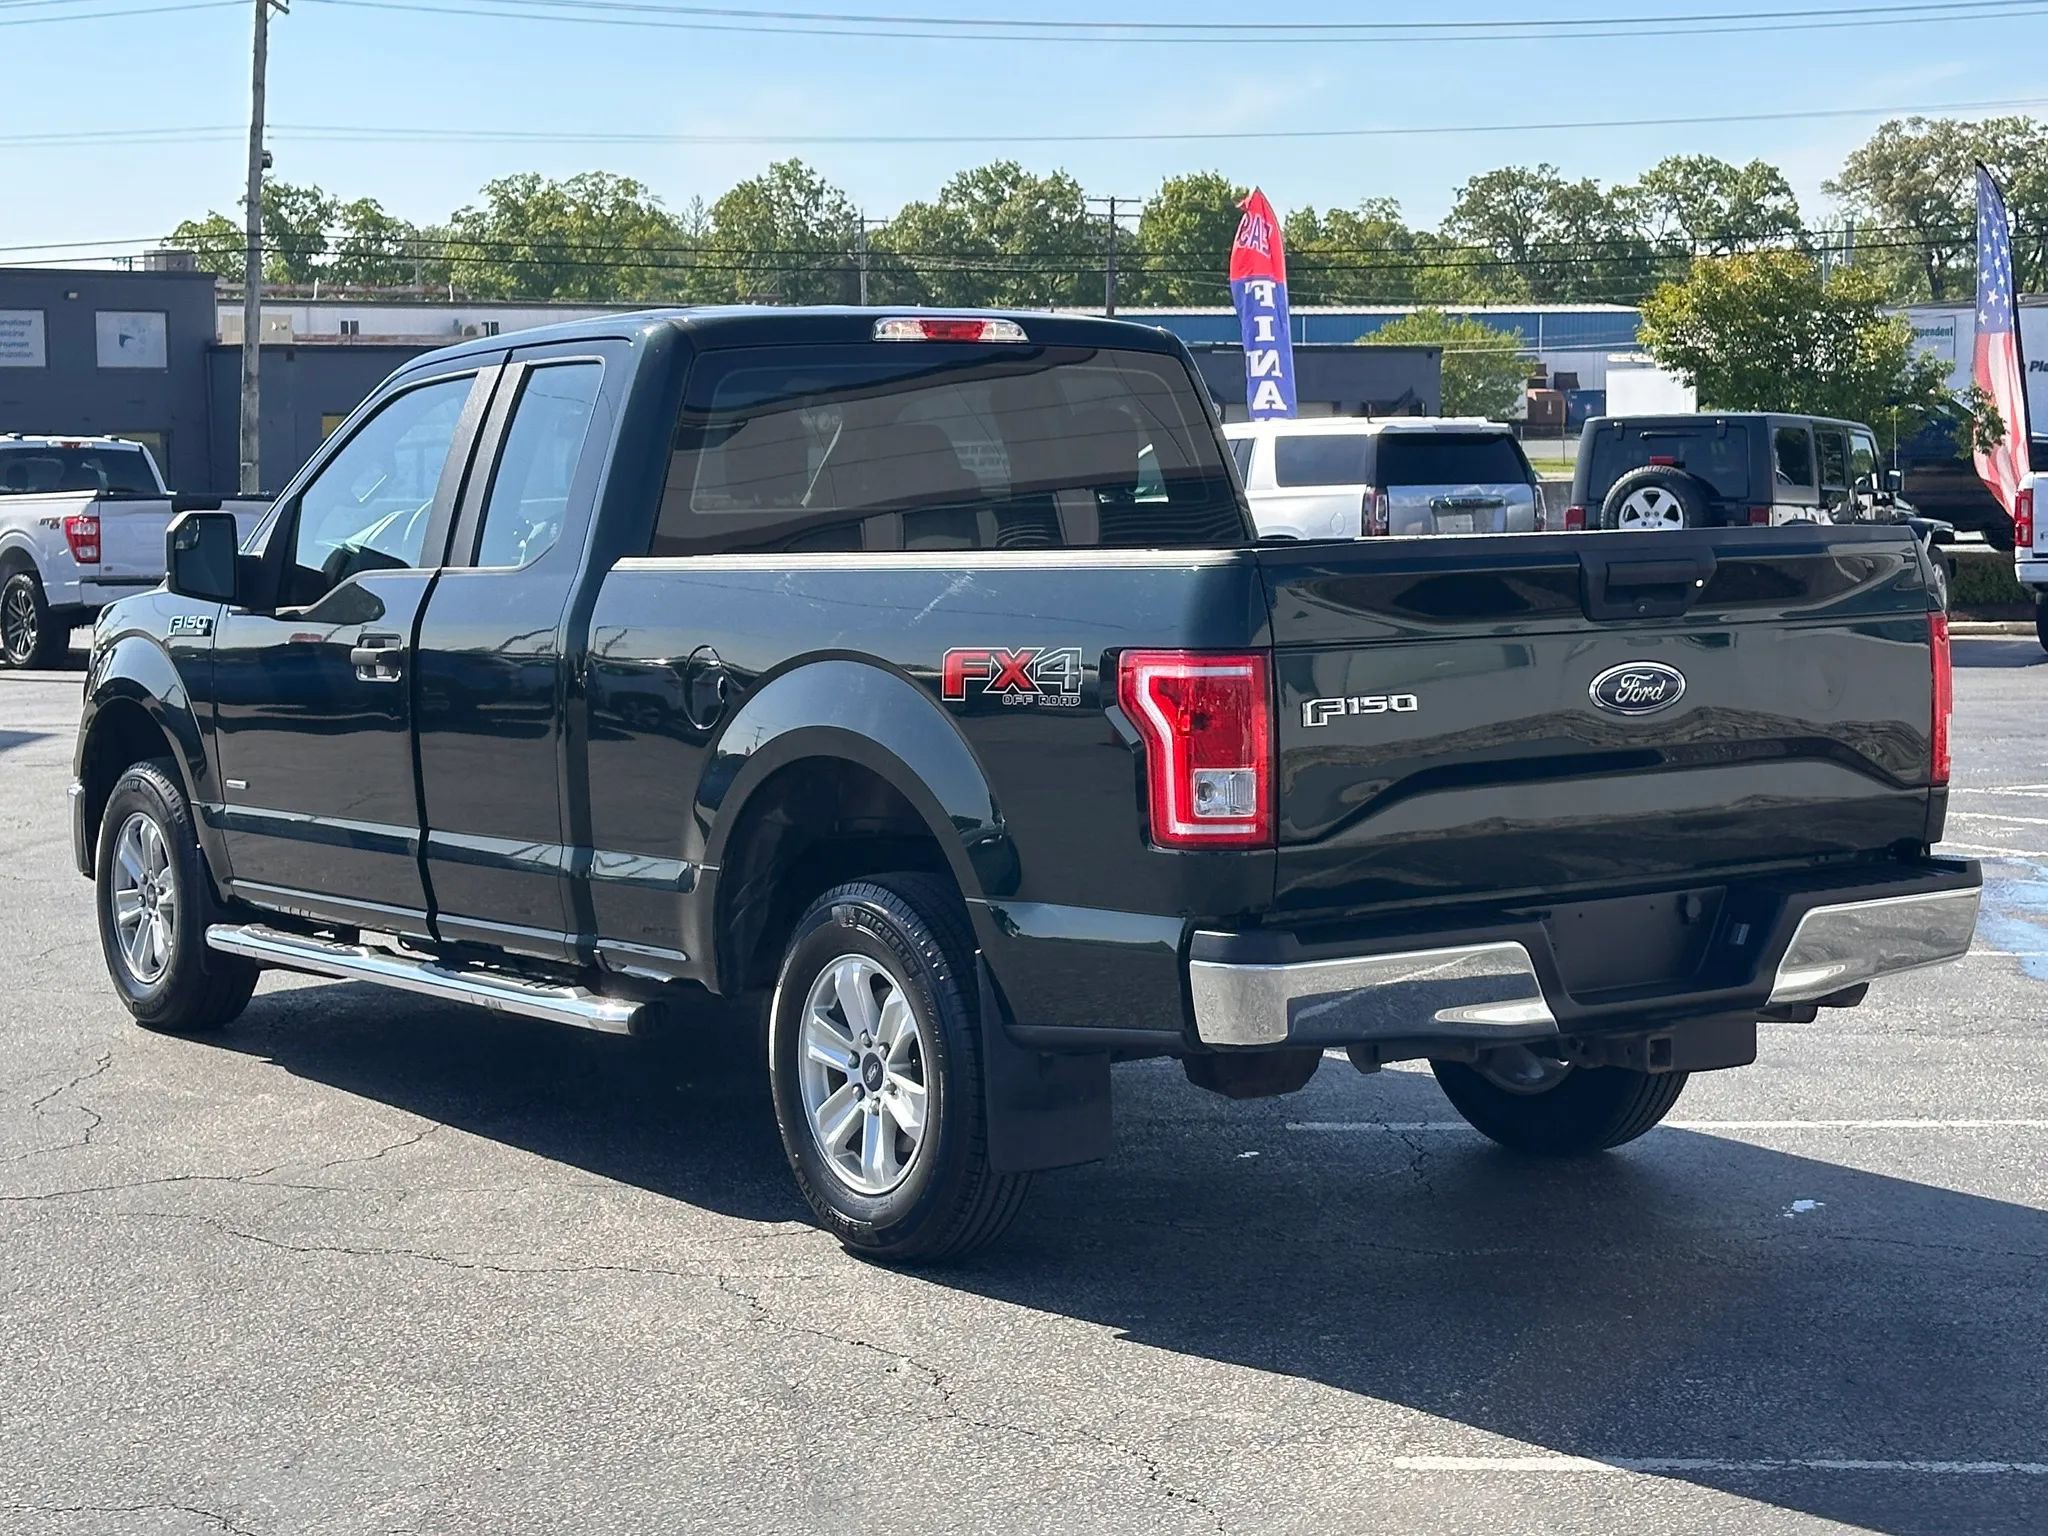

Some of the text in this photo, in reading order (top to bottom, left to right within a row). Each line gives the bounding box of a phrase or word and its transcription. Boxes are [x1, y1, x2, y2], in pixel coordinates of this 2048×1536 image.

[941, 647, 1083, 701] FX4
[1615, 673, 1666, 703] Ford
[1002, 694, 1081, 706] OFF ROAD
